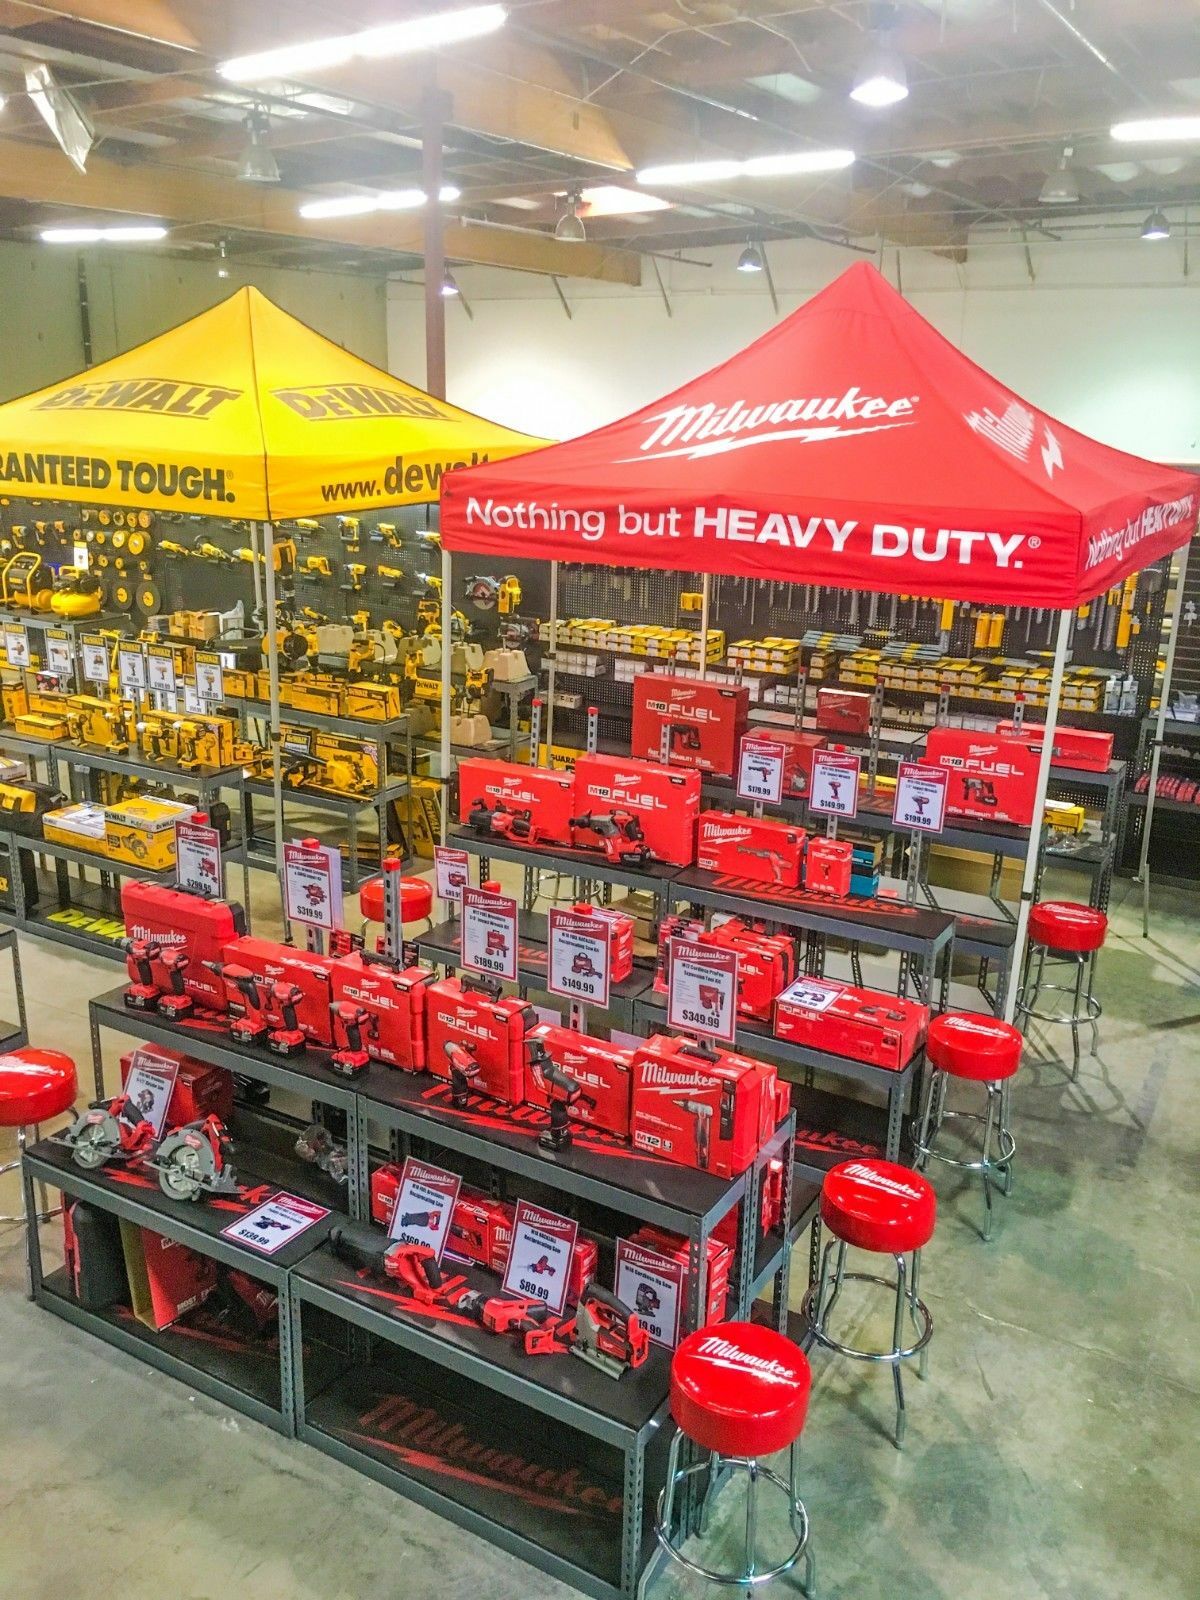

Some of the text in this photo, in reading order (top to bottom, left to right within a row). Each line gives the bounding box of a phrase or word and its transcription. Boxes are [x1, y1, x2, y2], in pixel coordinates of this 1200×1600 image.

[641, 387, 917, 449] Milwaukee
[466, 497, 606, 541] Nothing
[618, 505, 682, 537] but
[694, 507, 869, 553] HEAVY
[1084, 527, 1126, 571] Nothing
[416, 681, 440, 690] DEWALT
[647, 701, 666, 711] M18
[668, 703, 721, 722] FUEL
[551, 753, 576, 764] GUARA
[941, 756, 1025, 776] M18 FUEL
[503, 787, 541, 803] FUEL
[588, 786, 668, 809] M18 FUEL
[820, 800, 846, 811] $149.99
[904, 813, 932, 826] $199.99
[179, 826, 215, 838] Milwaukee
[702, 822, 752, 838] Milwaukee
[288, 850, 327, 862] Milwaukee
[466, 893, 512, 906] Milwaukee
[297, 905, 323, 920] $319.99
[553, 915, 604, 929] Milwaukee
[46, 908, 126, 941] DEW
[130, 924, 188, 944] Milwaukee
[675, 945, 731, 960] Milwaukee
[474, 955, 505, 971] $189.99
[189, 979, 218, 994] FUEL
[562, 976, 595, 994] $149.99
[360, 990, 400, 1009] FUEL
[682, 1009, 720, 1029] $349.99
[456, 1018, 499, 1041] FUEL
[562, 1064, 611, 1089] FUEL
[637, 1060, 721, 1087] Milwaukee
[636, 1132, 660, 1147] M12
[409, 1165, 456, 1184] Milwaukee
[844, 1163, 922, 1199] Milwaukee
[521, 1208, 573, 1230] Milwaukee
[238, 1229, 270, 1245] $139.99
[623, 1247, 676, 1271] Milwaukee
[519, 1279, 549, 1301] $89.99
[698, 1336, 796, 1378] Milwaukee
